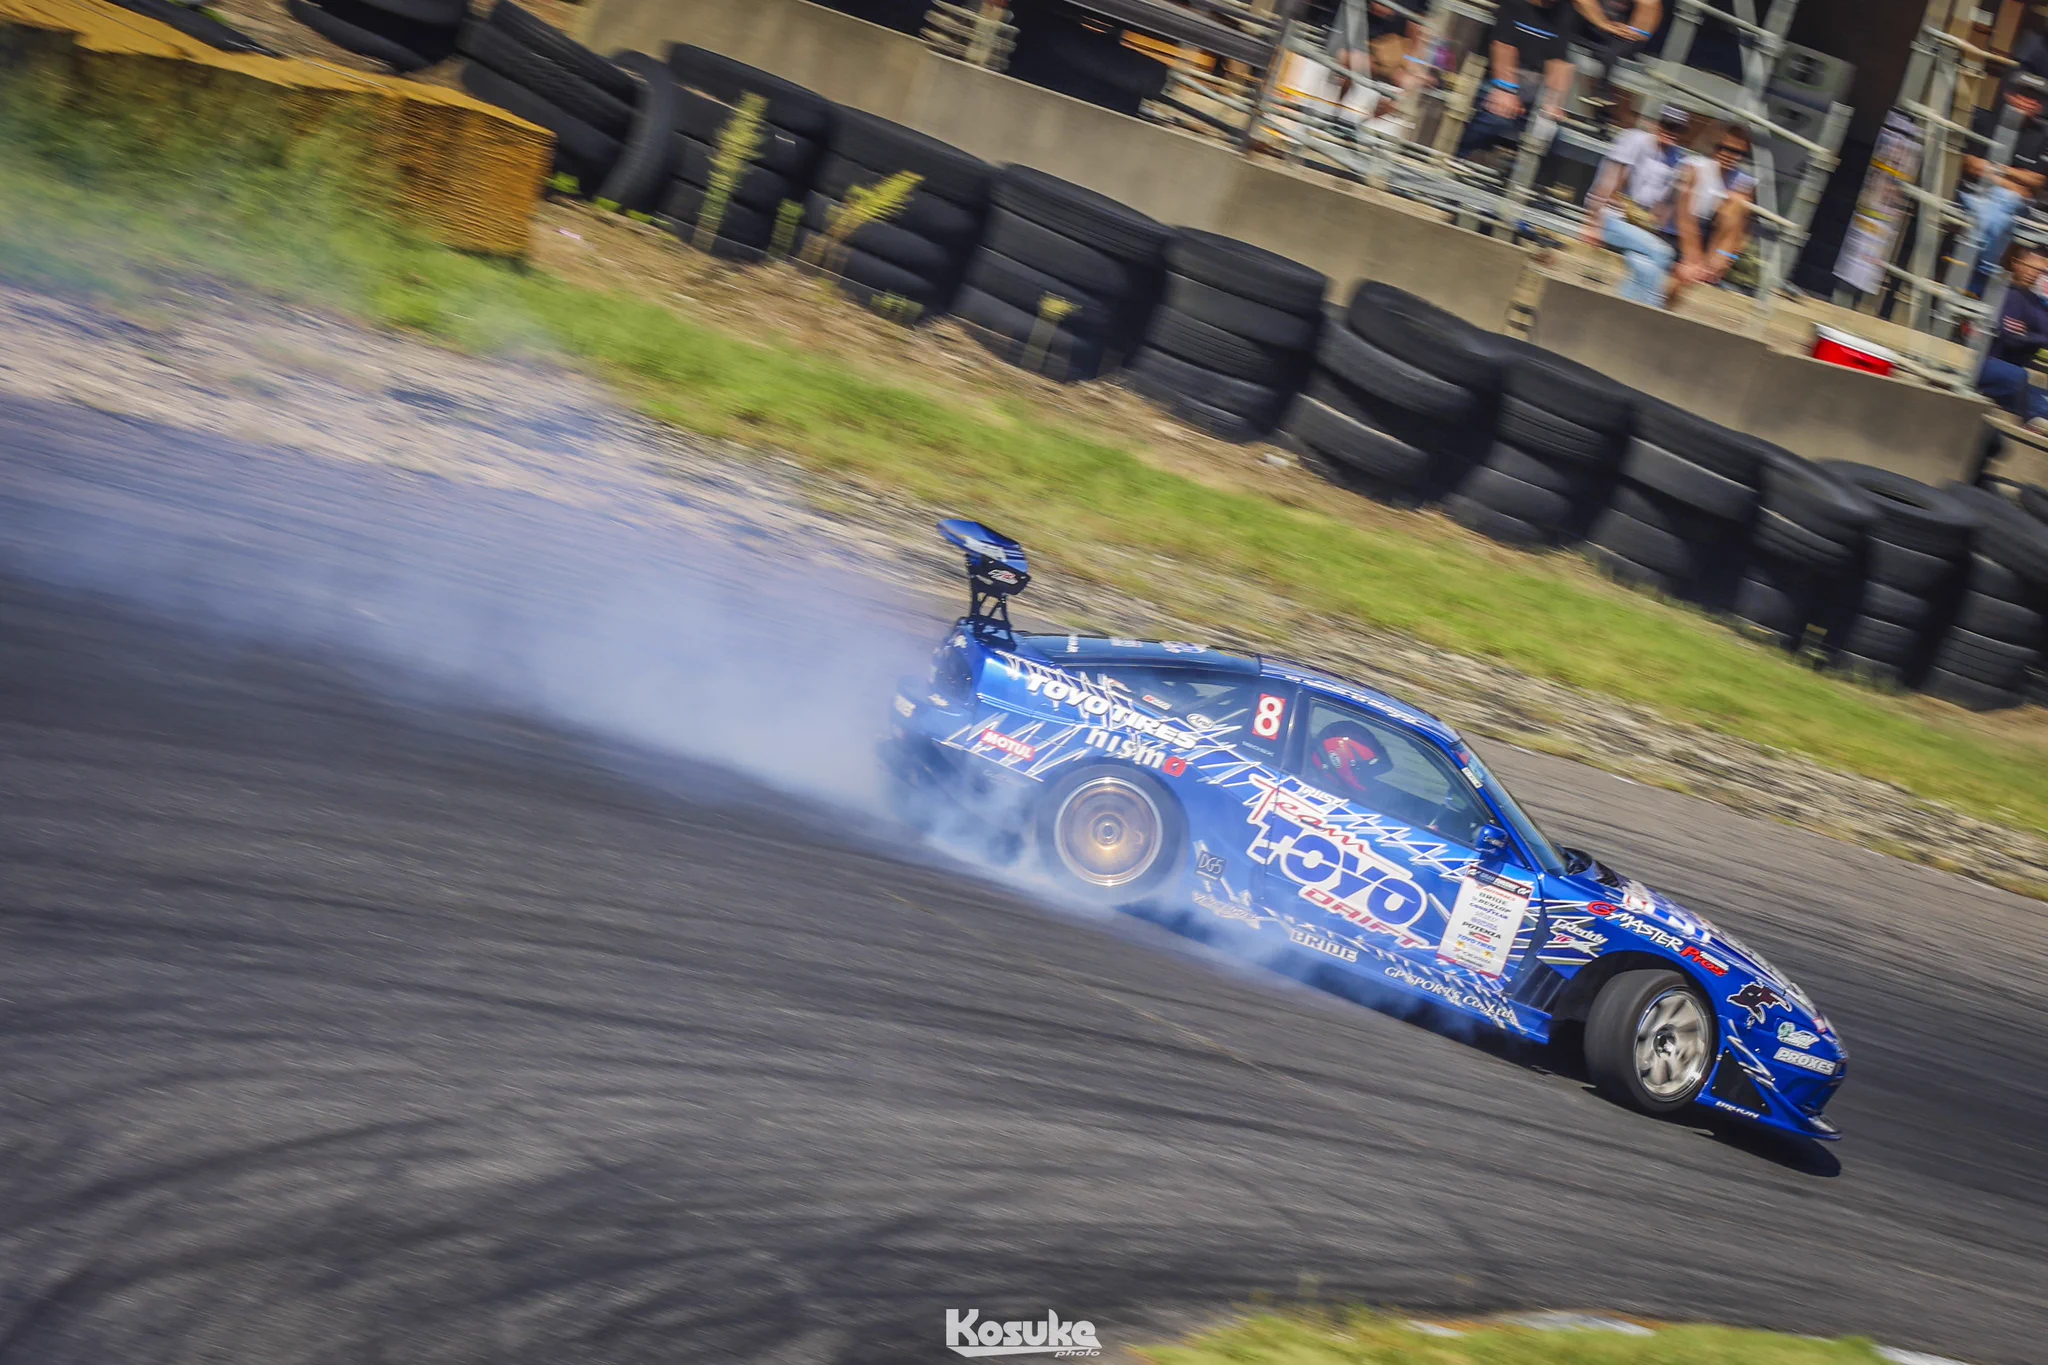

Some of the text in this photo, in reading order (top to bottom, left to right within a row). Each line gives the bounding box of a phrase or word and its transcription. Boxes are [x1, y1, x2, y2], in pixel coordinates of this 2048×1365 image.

[1027, 674, 1199, 750] TOYO TIRES
[1253, 696, 1283, 737] 8
[982, 730, 1034, 760] MOTUL
[1250, 776, 1388, 866] Team
[1302, 887, 1427, 947] DRIFT
[1461, 921, 1502, 940] POTENZA
[1290, 929, 1358, 962] BRIDE
[1777, 1047, 1836, 1075] PROXES
